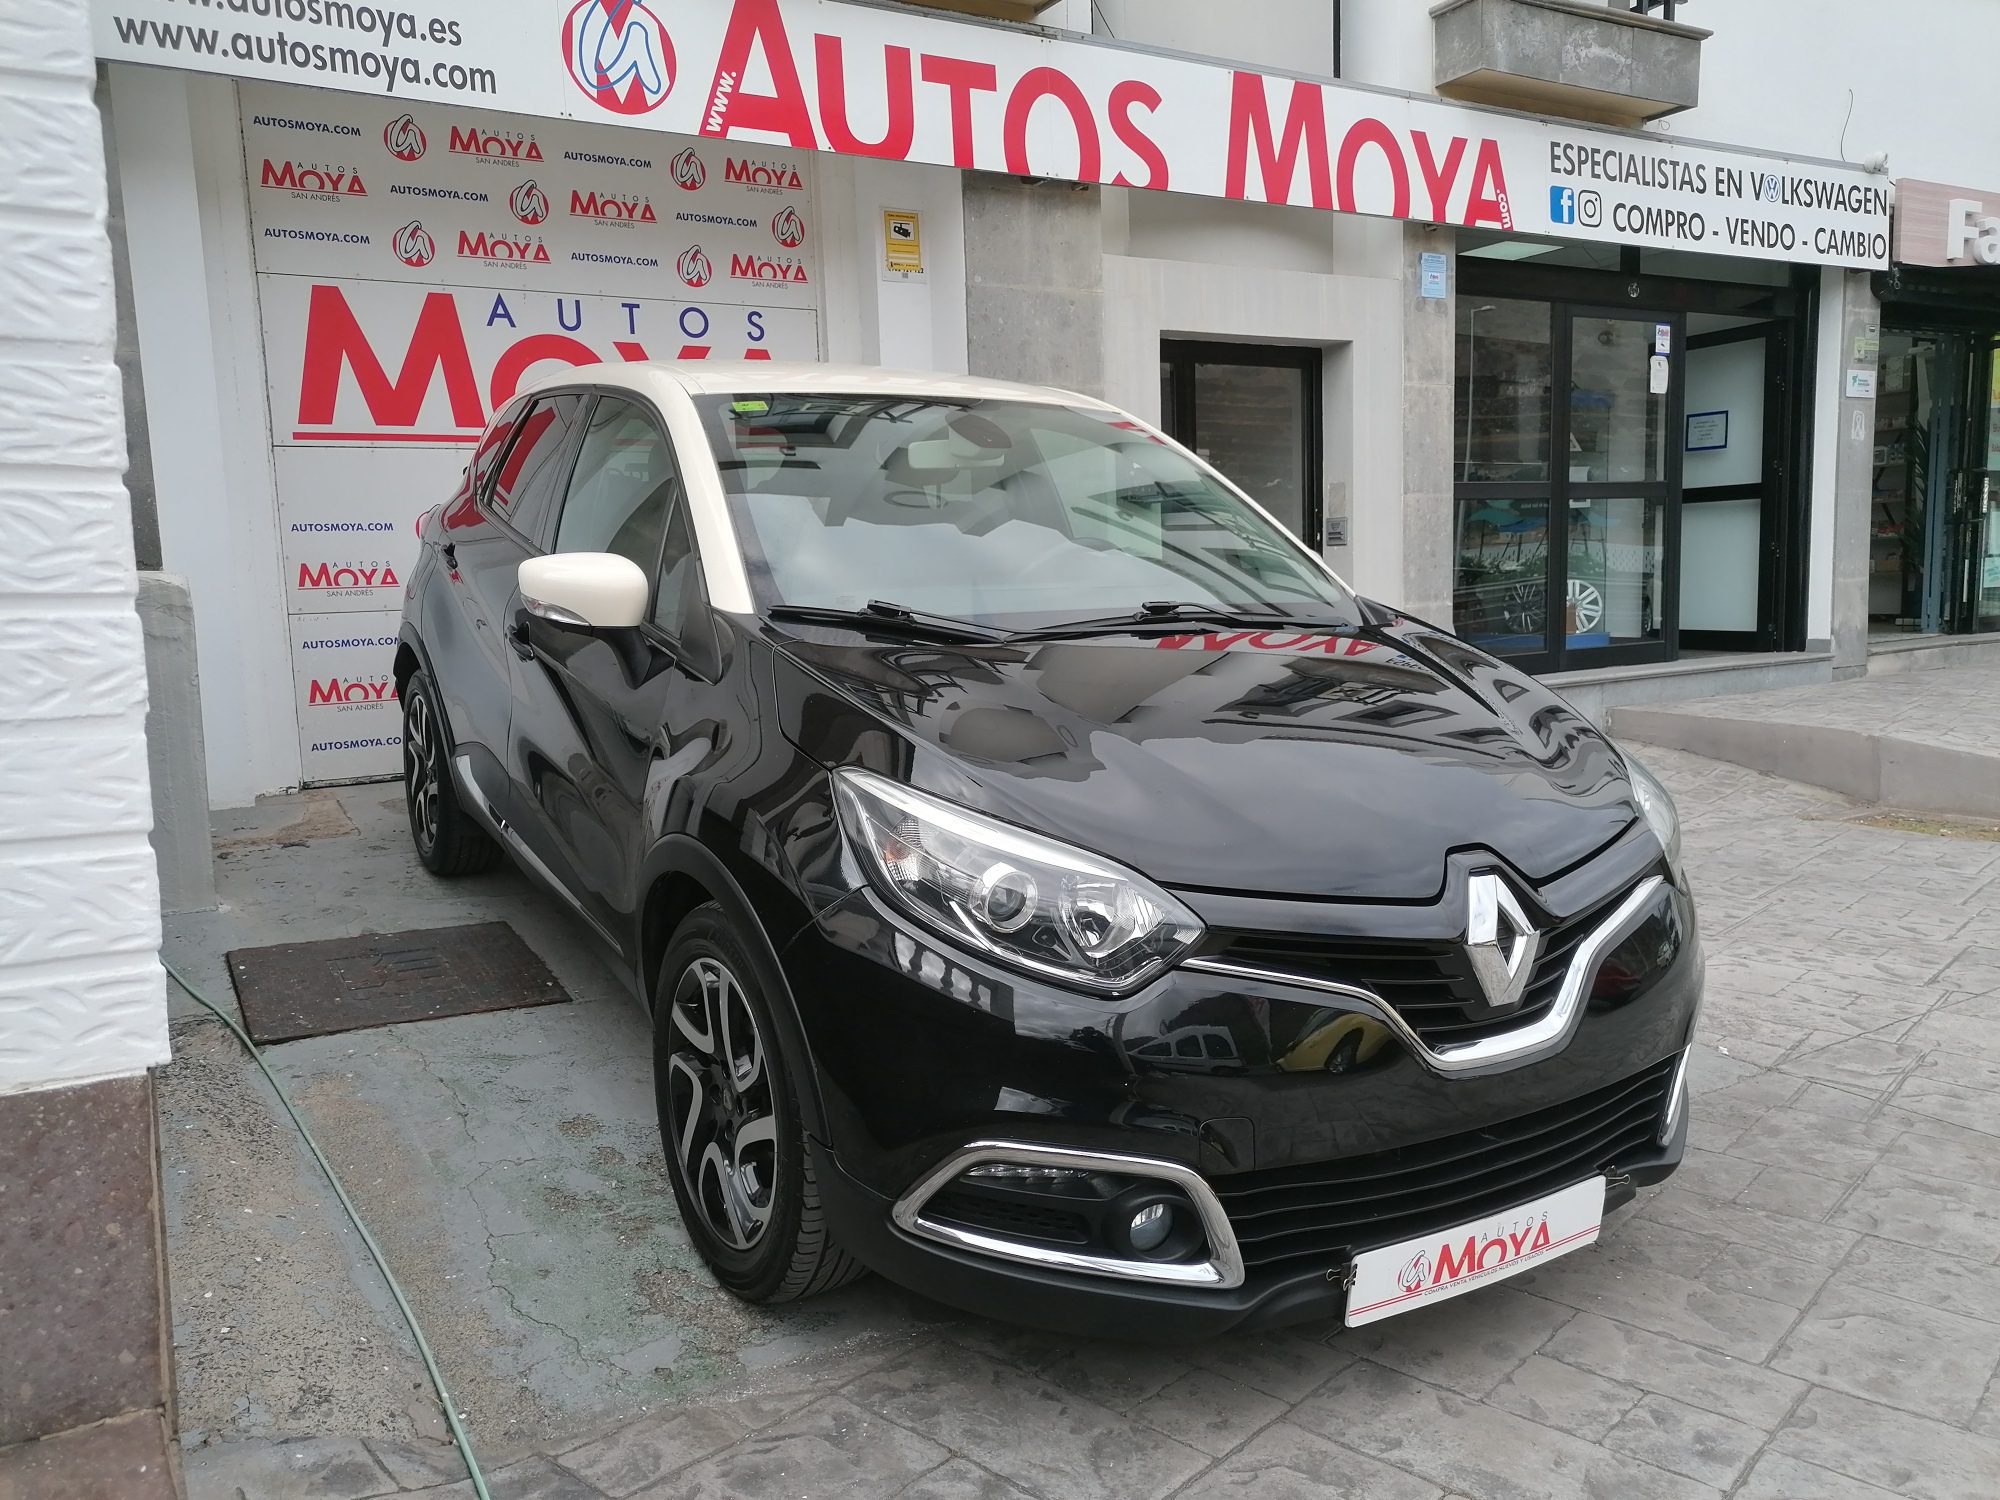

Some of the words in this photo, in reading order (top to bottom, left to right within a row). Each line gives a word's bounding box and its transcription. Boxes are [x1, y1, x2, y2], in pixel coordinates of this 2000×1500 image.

[112, 16, 497, 93] www.autosmoya.com
[697, 0, 1169, 192] AUTOS
[1225, 71, 1515, 231] MOYA
[253, 115, 361, 137] AUTOSMOYA.COM
[450, 126, 543, 159] MOYA
[481, 128, 536, 141] AUTOS
[475, 157, 492, 165] SAN
[563, 151, 652, 169] AUTOSMOYA.COM
[751, 160, 798, 171] AUTOS
[261, 158, 368, 194] MOYA
[297, 162, 359, 175] AUTOS
[725, 157, 802, 189] MOYA
[1550, 141, 1707, 194] ESPECIALISTAS
[1715, 166, 1743, 199] EN
[291, 191, 309, 201] SAN
[390, 184, 489, 203] AUTOSMOYA.COM
[599, 192, 650, 203] AUTOS
[746, 185, 760, 194] SAN
[570, 189, 657, 222] MOYA
[594, 219, 609, 228] SAN
[675, 212, 758, 228] AUTOSMOYA.COM
[264, 228, 371, 245] AUTOSMOYA.COM
[489, 232, 543, 243] AUTOS
[1613, 202, 1706, 241] COMPRO
[1725, 216, 1796, 251] VENDO
[1814, 227, 1887, 260] CAMBIO
[457, 230, 551, 261] MOYA
[571, 252, 659, 268] AUTOSMOYA.COM
[730, 253, 808, 281] MOYA
[756, 256, 803, 265] AUTOS
[486, 293, 765, 342] AUTOS
[291, 522, 394, 532] AUTOSMOYA.COM
[332, 560, 391, 569] AUTOS
[298, 562, 400, 587] MOYA
[326, 589, 343, 598] SAN
[342, 674, 389, 684] AUTO
[336, 705, 353, 713] SAN
[311, 737, 402, 752] AUTOSMOYA.CO
[1481, 1211, 1548, 1243] AUTOS
[1432, 1221, 1551, 1285] MOYA
